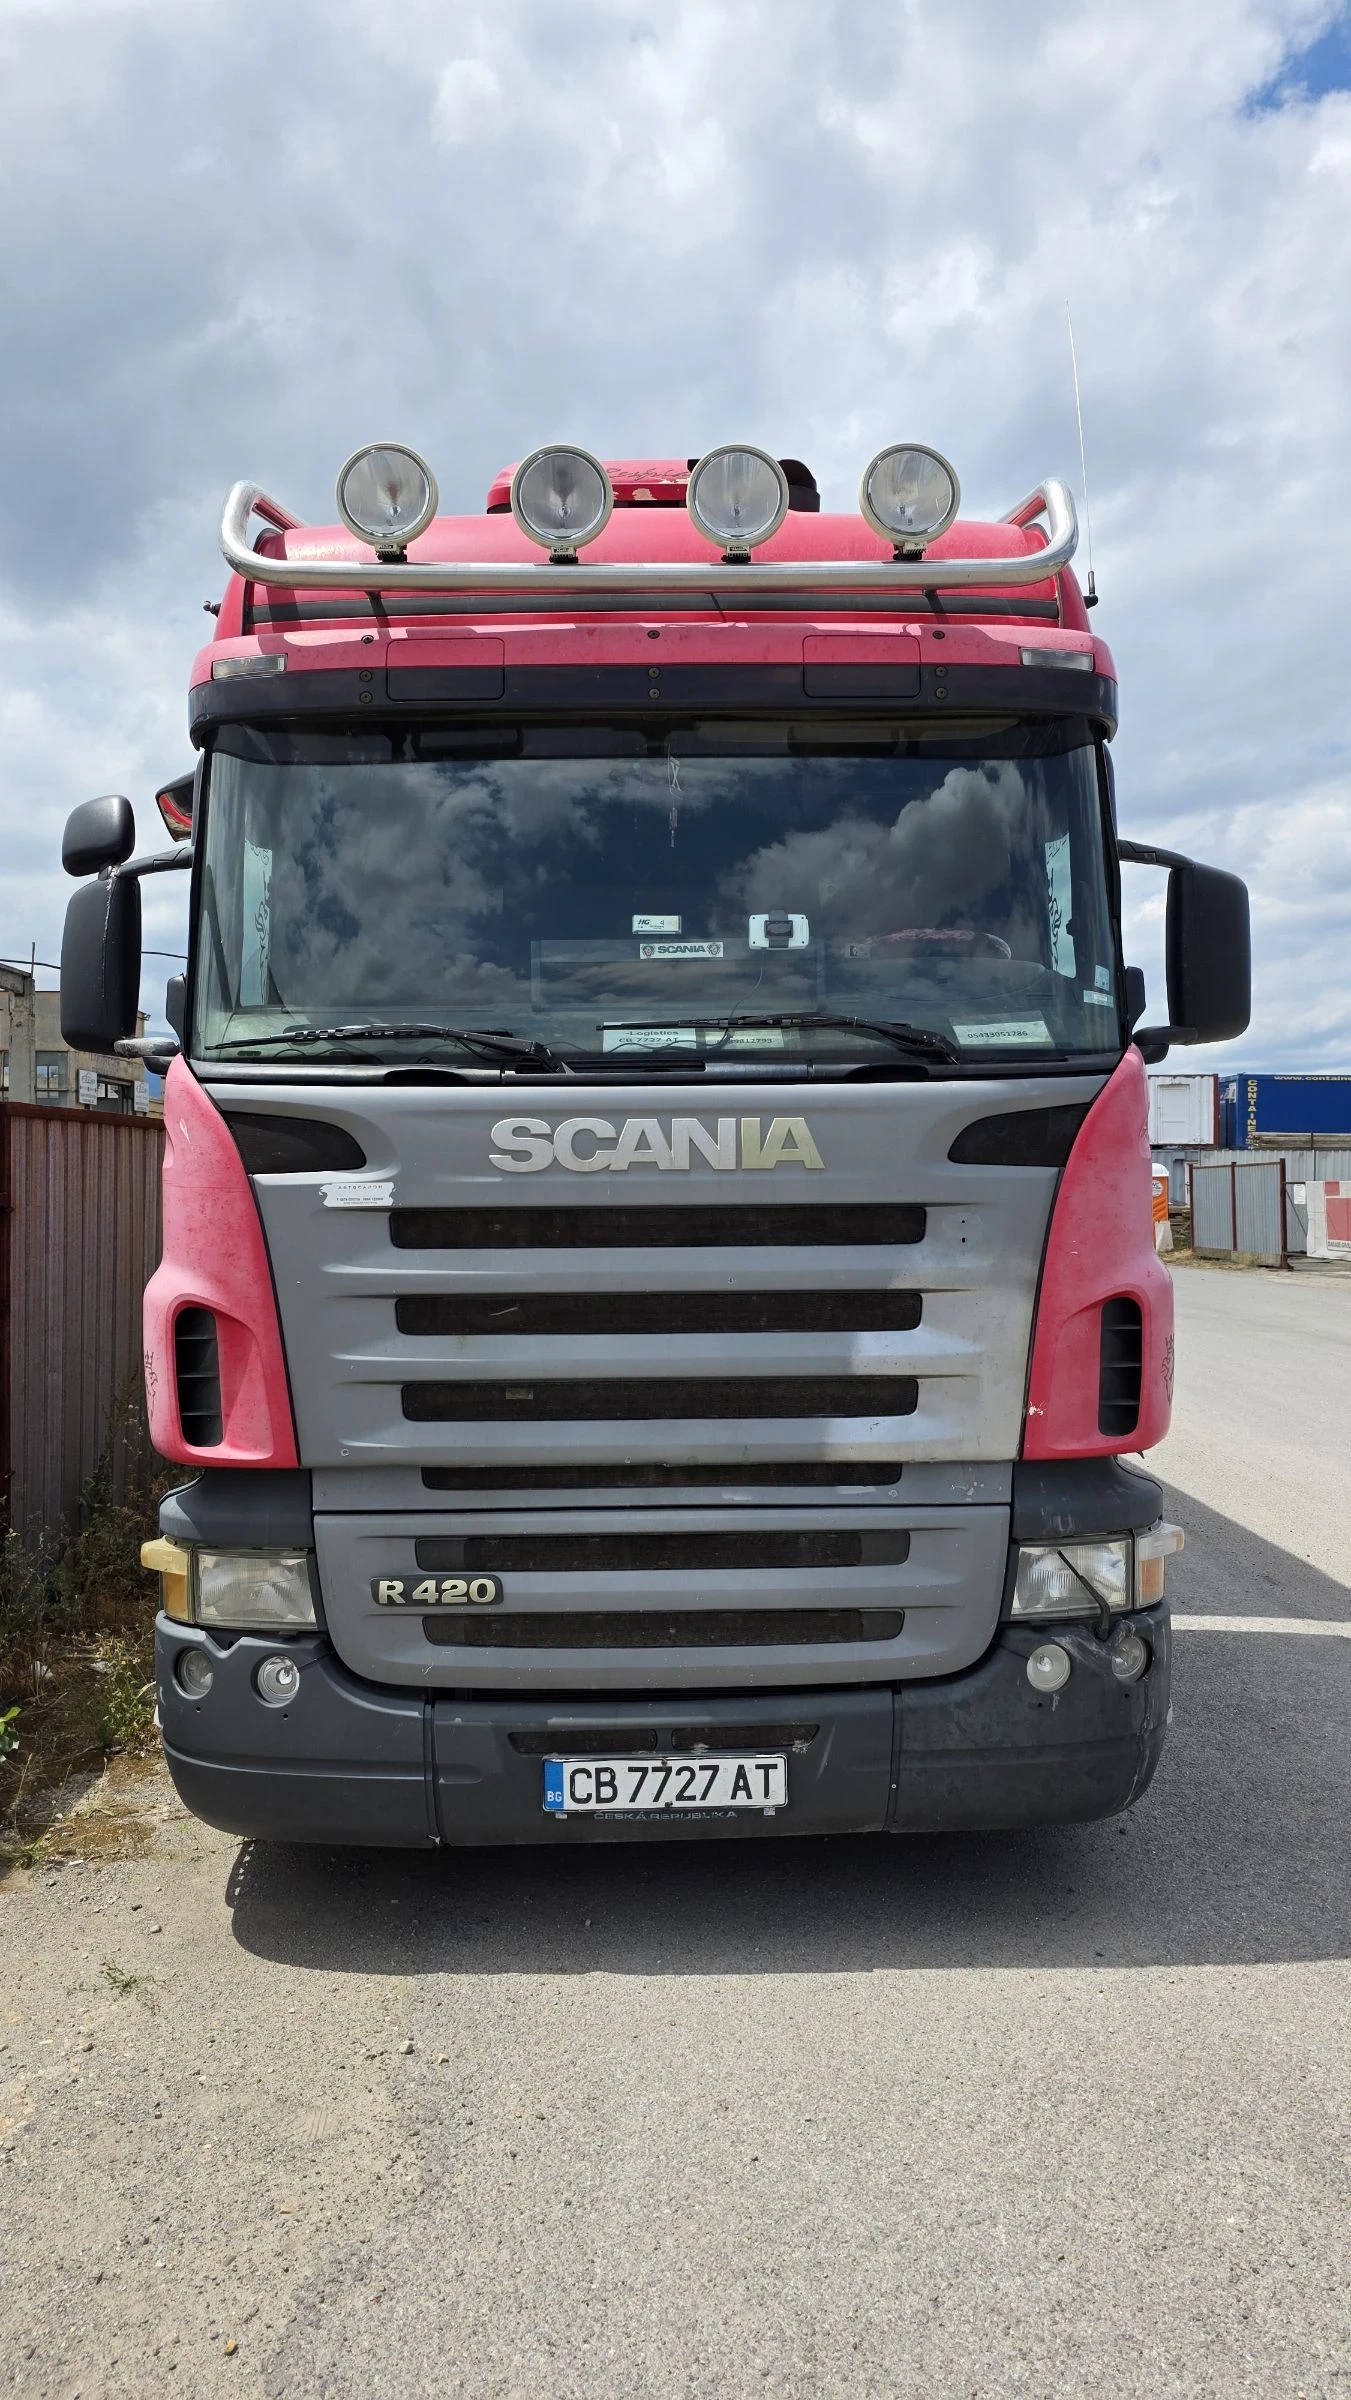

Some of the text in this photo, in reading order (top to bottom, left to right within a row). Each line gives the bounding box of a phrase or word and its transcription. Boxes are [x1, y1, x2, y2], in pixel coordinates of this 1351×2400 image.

[657, 945, 706, 954] SCANIA
[488, 1117, 826, 1173] SCANIA
[378, 1579, 496, 1604] R 420
[547, 1790, 563, 1803] BG
[569, 1763, 779, 1805] CB 7727 AT
